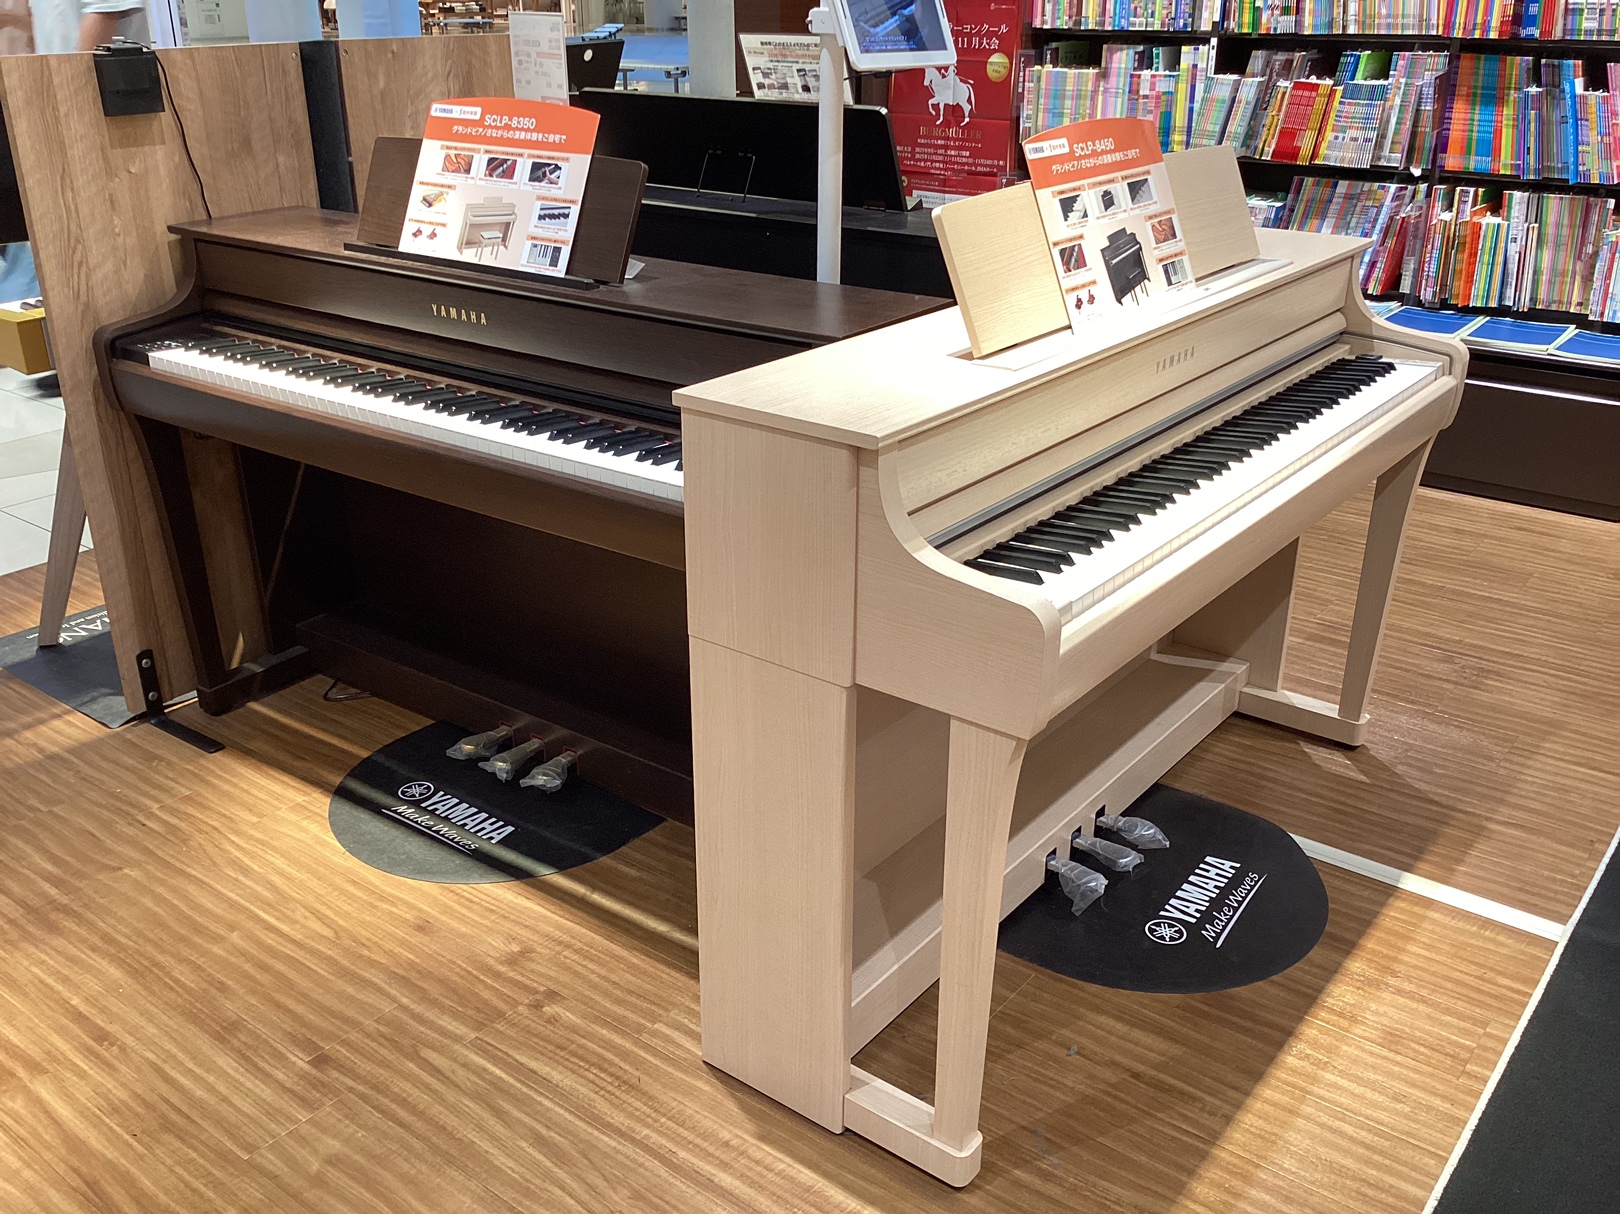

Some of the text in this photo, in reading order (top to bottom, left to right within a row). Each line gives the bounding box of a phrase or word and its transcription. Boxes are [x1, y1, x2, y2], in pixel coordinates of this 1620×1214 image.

[452, 125, 566, 143] グランドピアノさながらの演奏体験をご自宅で
[484, 114, 536, 129] SCLP-8350
[920, 126, 982, 139] BURGMÜLLER
[1073, 138, 1115, 157] SCLP-8450
[431, 303, 487, 326] YAMAHA
[1156, 346, 1195, 374] YAMAHA
[391, 805, 479, 850] Make Waves
[420, 791, 516, 844] YAMAHA
[1158, 855, 1241, 924] YAMAHA
[1201, 871, 1259, 942] Make Waves
